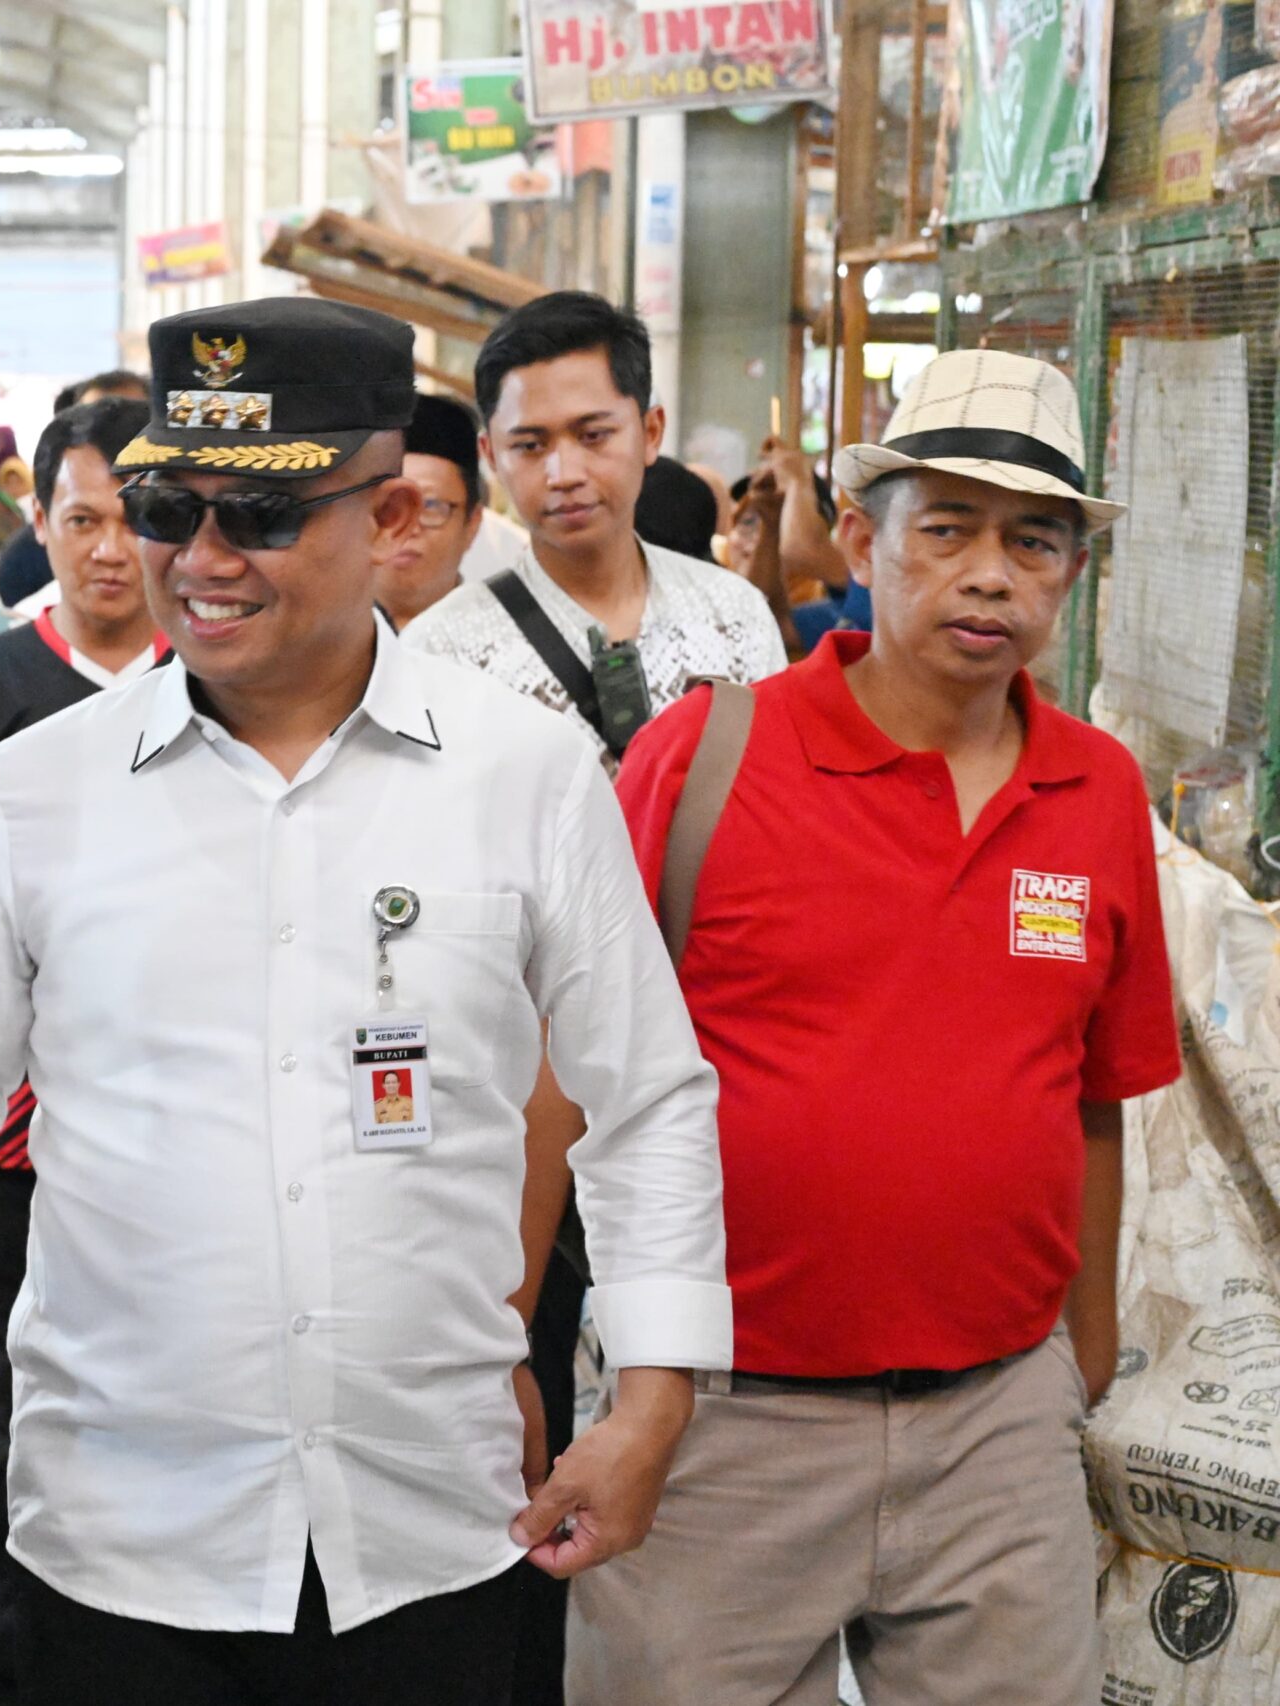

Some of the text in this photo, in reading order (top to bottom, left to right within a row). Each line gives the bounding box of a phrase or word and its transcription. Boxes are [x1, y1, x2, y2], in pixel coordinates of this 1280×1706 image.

[543, 0, 815, 70] Hj. INTAN
[589, 61, 776, 103] BUMBON
[1016, 874, 1086, 901] TRADE
[373, 1050, 408, 1061] BUPATI
[375, 1031, 417, 1042] KEBUMEN
[1127, 1443, 1280, 1501] EPUNG TERIGU
[1128, 1483, 1280, 1542] BAKUNG
